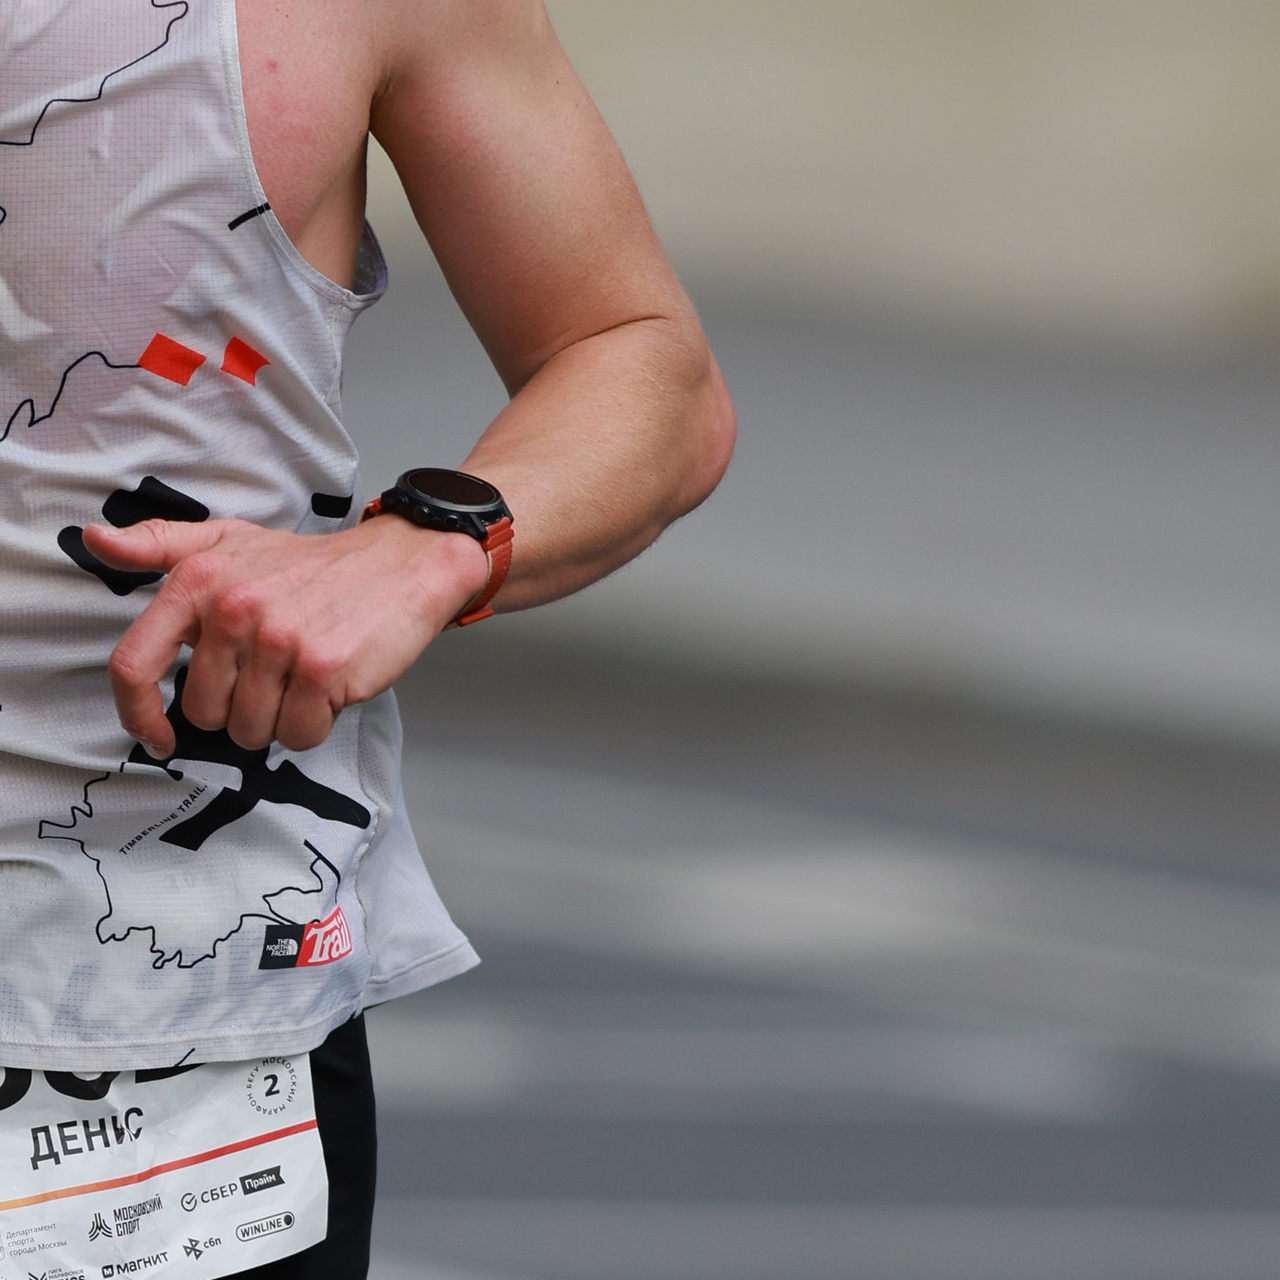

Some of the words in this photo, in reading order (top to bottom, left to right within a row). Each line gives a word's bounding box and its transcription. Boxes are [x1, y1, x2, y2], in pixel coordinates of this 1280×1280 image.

[119, 812, 178, 855] TIMBERLINE
[306, 910, 351, 963] Trail
[262, 1057, 297, 1103] МОСКОВСКИЙ
[263, 1074, 280, 1097] 2
[247, 1093, 286, 1116] МАРАФОН
[30, 1107, 144, 1171] ДЕНИС
[200, 1183, 238, 1203] СБЕР
[245, 1175, 276, 1190] Прайм
[113, 1194, 163, 1223] МОСКОВСКИЙ
[6, 1223, 57, 1239] Департамент
[115, 1218, 141, 1237] СПОРТ
[241, 1218, 282, 1238] WINLINE
[8, 1237, 34, 1248] спорта
[10, 1245, 37, 1256] города
[38, 1240, 67, 1251] Москвы
[203, 1237, 221, 1249] сбп
